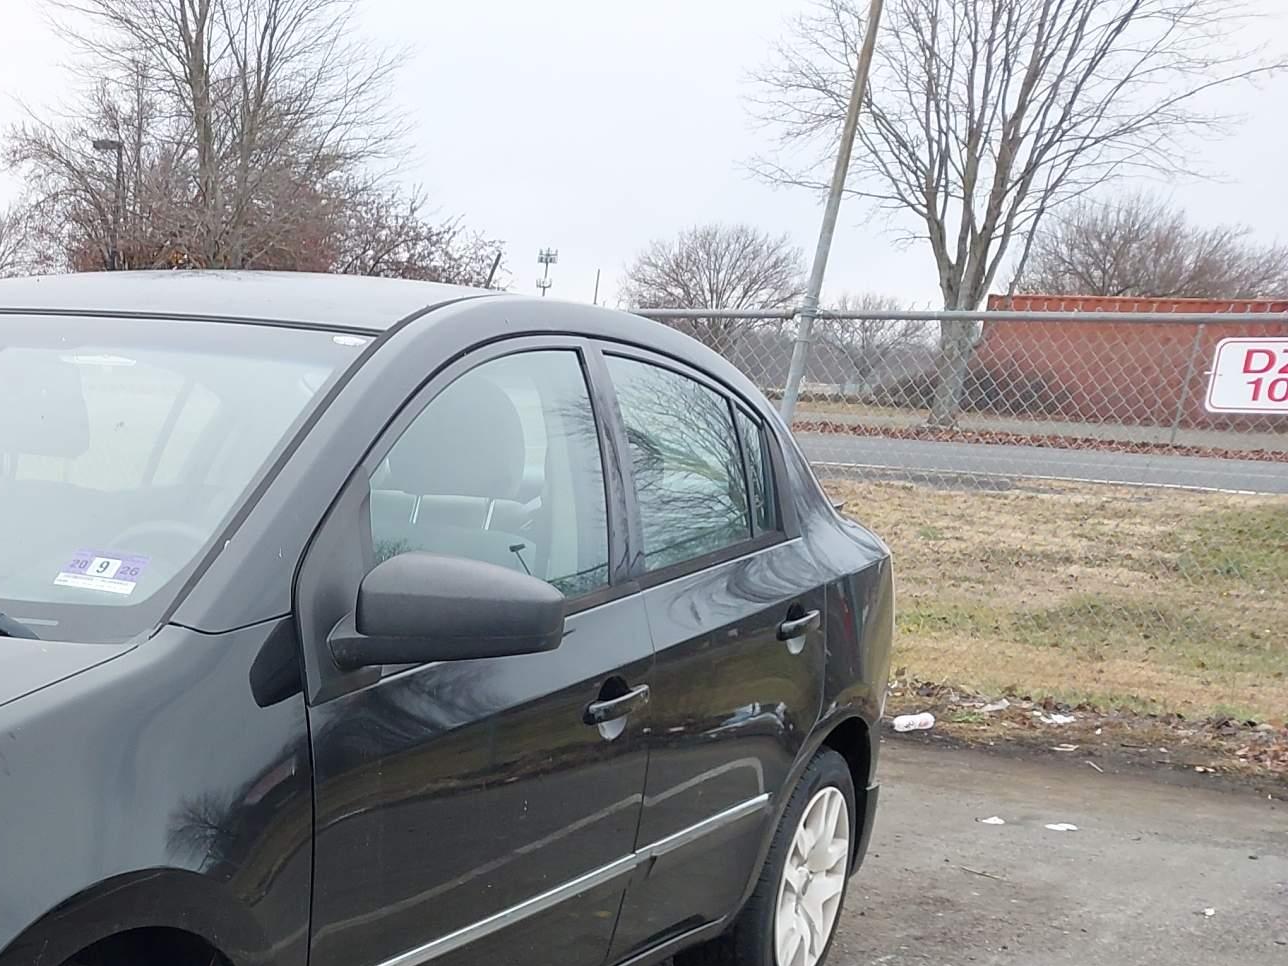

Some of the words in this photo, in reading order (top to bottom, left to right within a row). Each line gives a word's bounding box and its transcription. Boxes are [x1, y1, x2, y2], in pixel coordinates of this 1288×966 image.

[1246, 377, 1288, 402] 10
[95, 560, 110, 574] 9
[119, 566, 141, 577] 26
